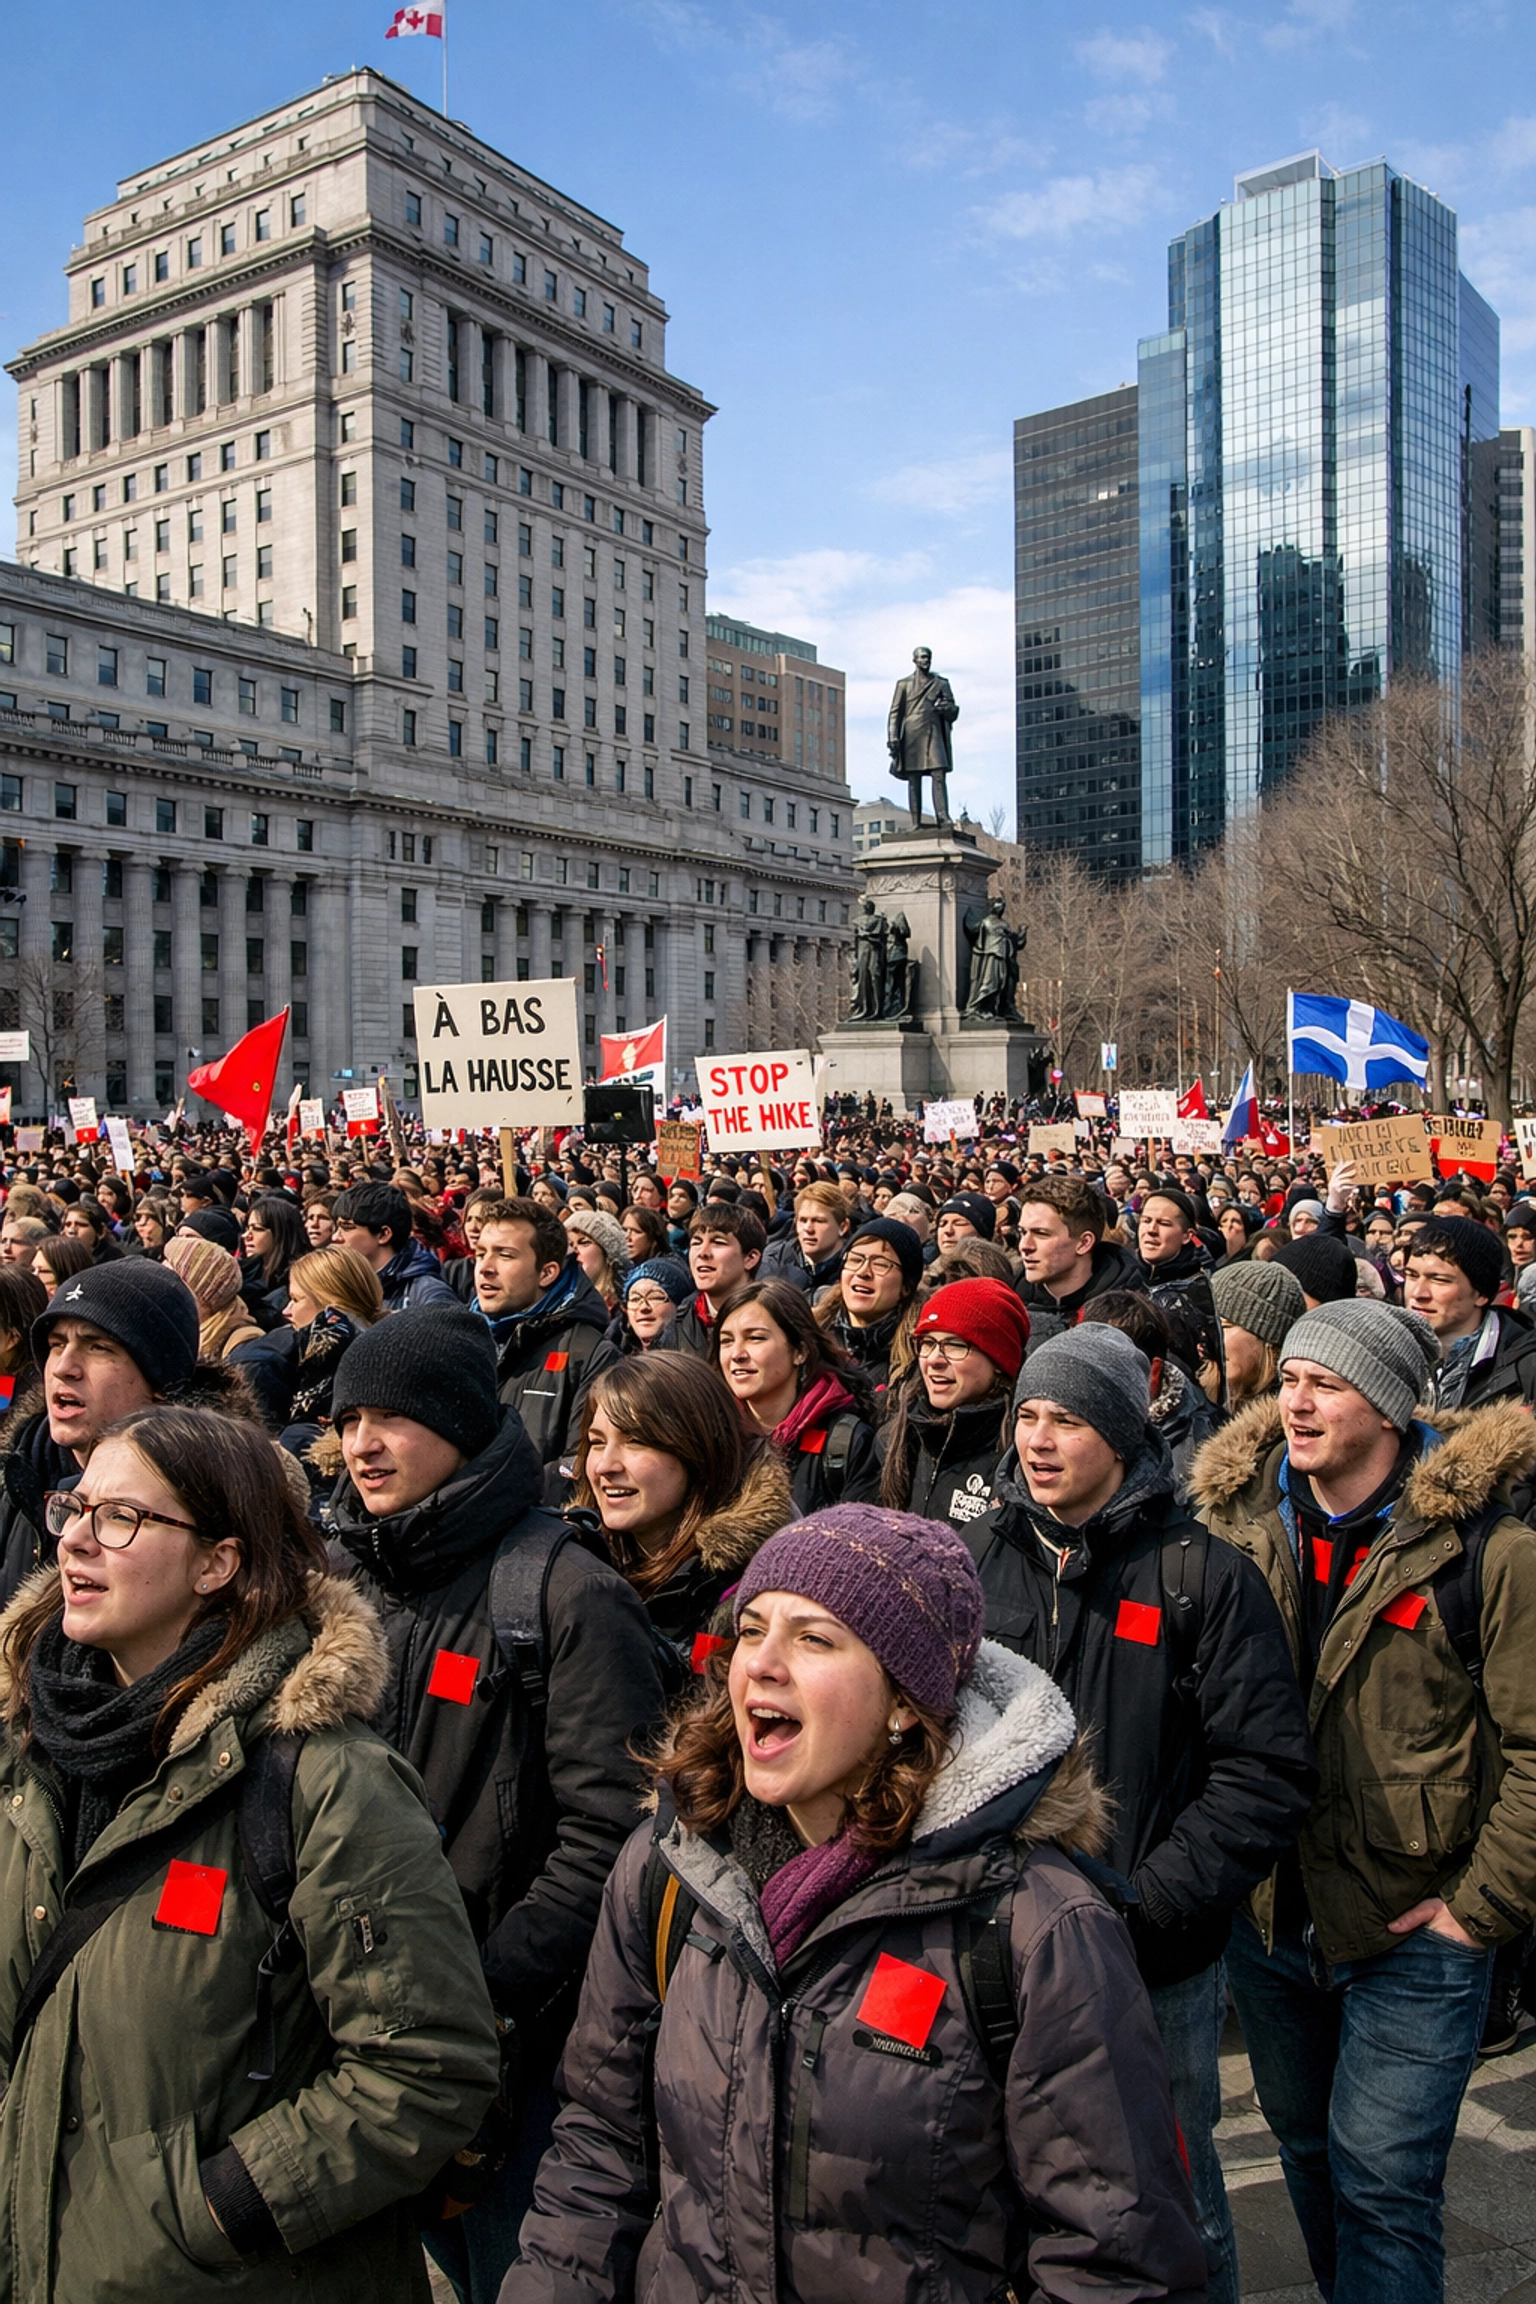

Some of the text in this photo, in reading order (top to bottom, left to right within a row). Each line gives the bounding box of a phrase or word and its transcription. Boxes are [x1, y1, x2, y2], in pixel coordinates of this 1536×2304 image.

[432, 992, 546, 1038] À BAS
[424, 1060, 459, 1094] LA
[467, 1058, 573, 1093] HAUSSE
[709, 1062, 790, 1098] STOP
[707, 1101, 814, 1135] THE HIKE
